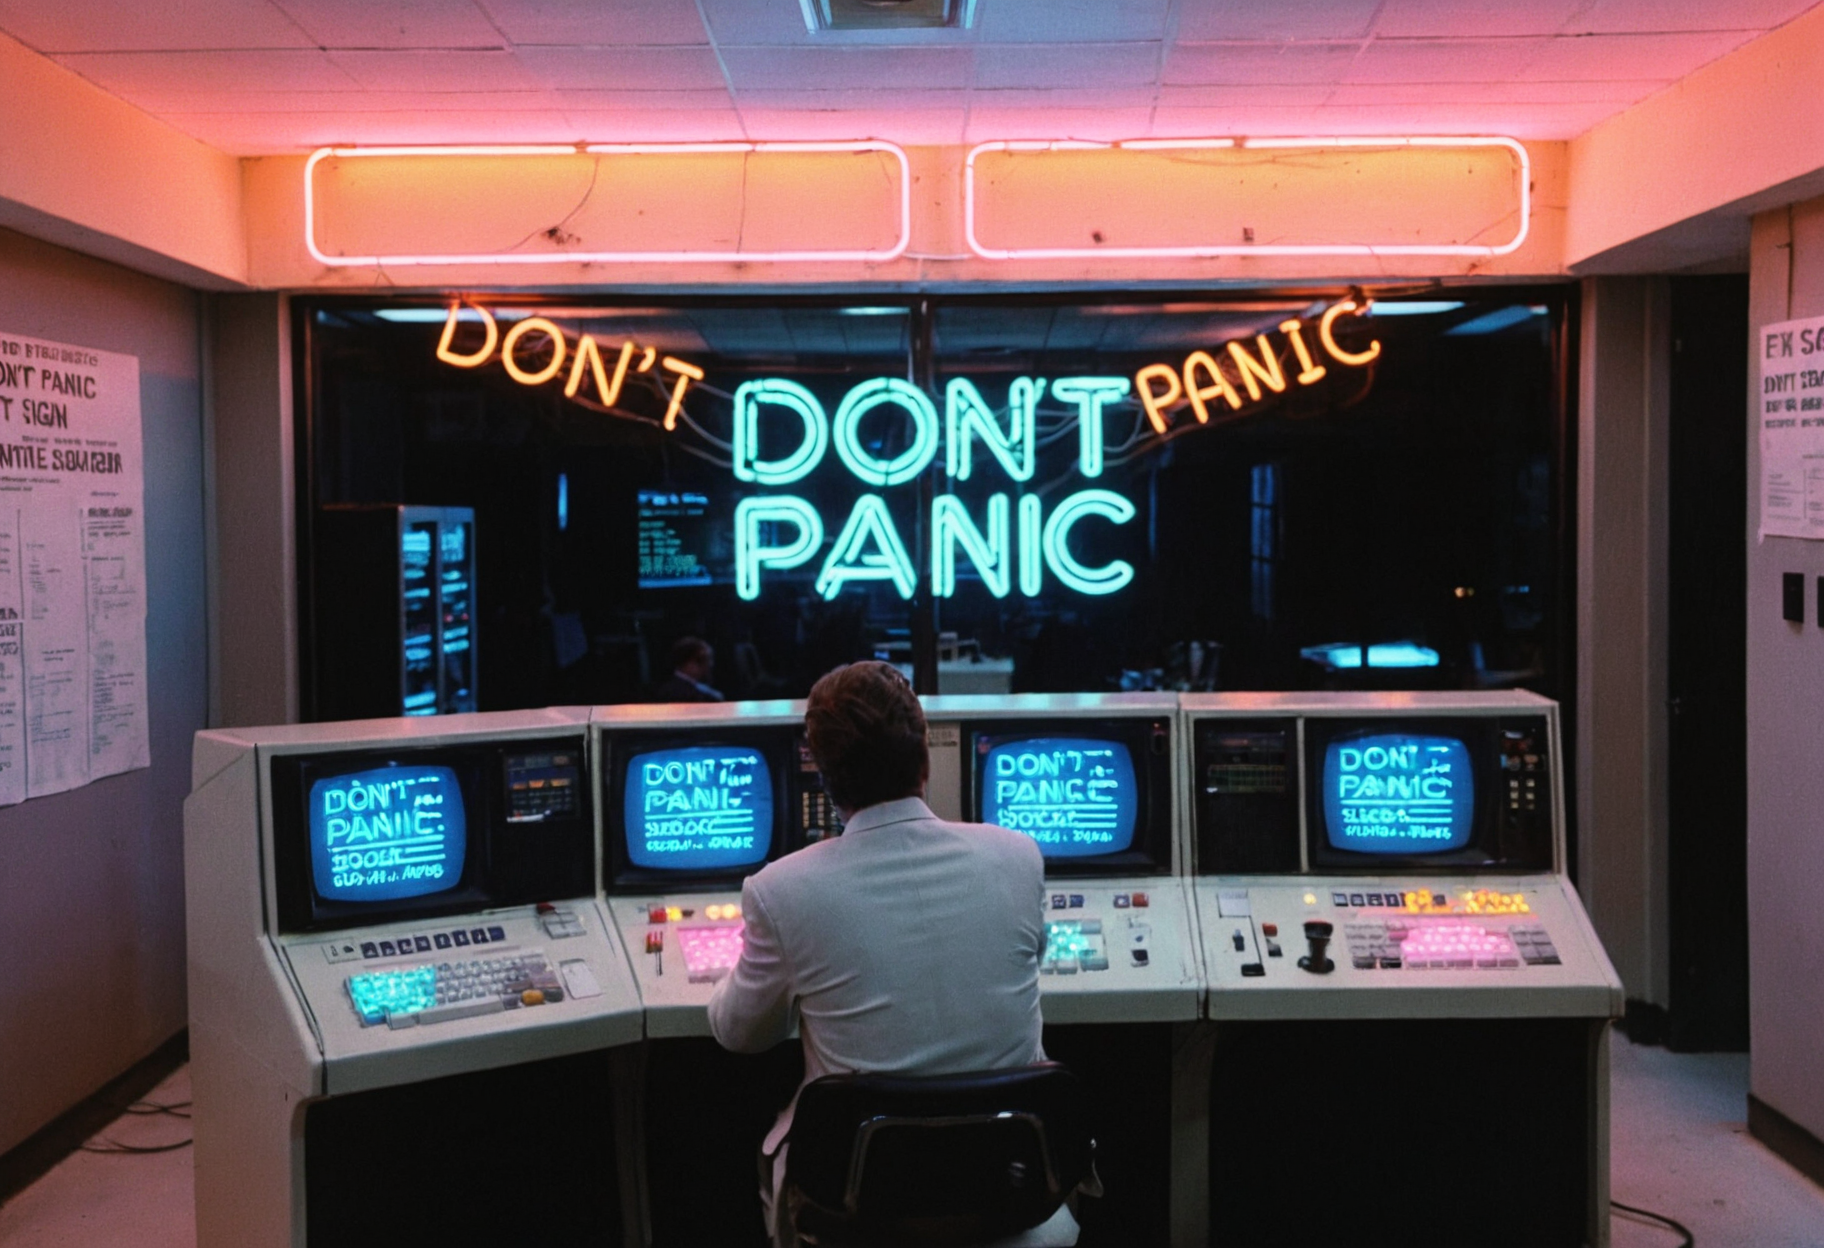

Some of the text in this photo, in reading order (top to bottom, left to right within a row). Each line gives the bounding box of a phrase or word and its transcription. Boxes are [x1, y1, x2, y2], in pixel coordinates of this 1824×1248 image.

[41, 368, 97, 399] PANIC
[436, 298, 705, 431] DON'T
[1135, 300, 1381, 434] PANIC
[733, 376, 1131, 486] DON'T
[734, 489, 1136, 600] PANIC
